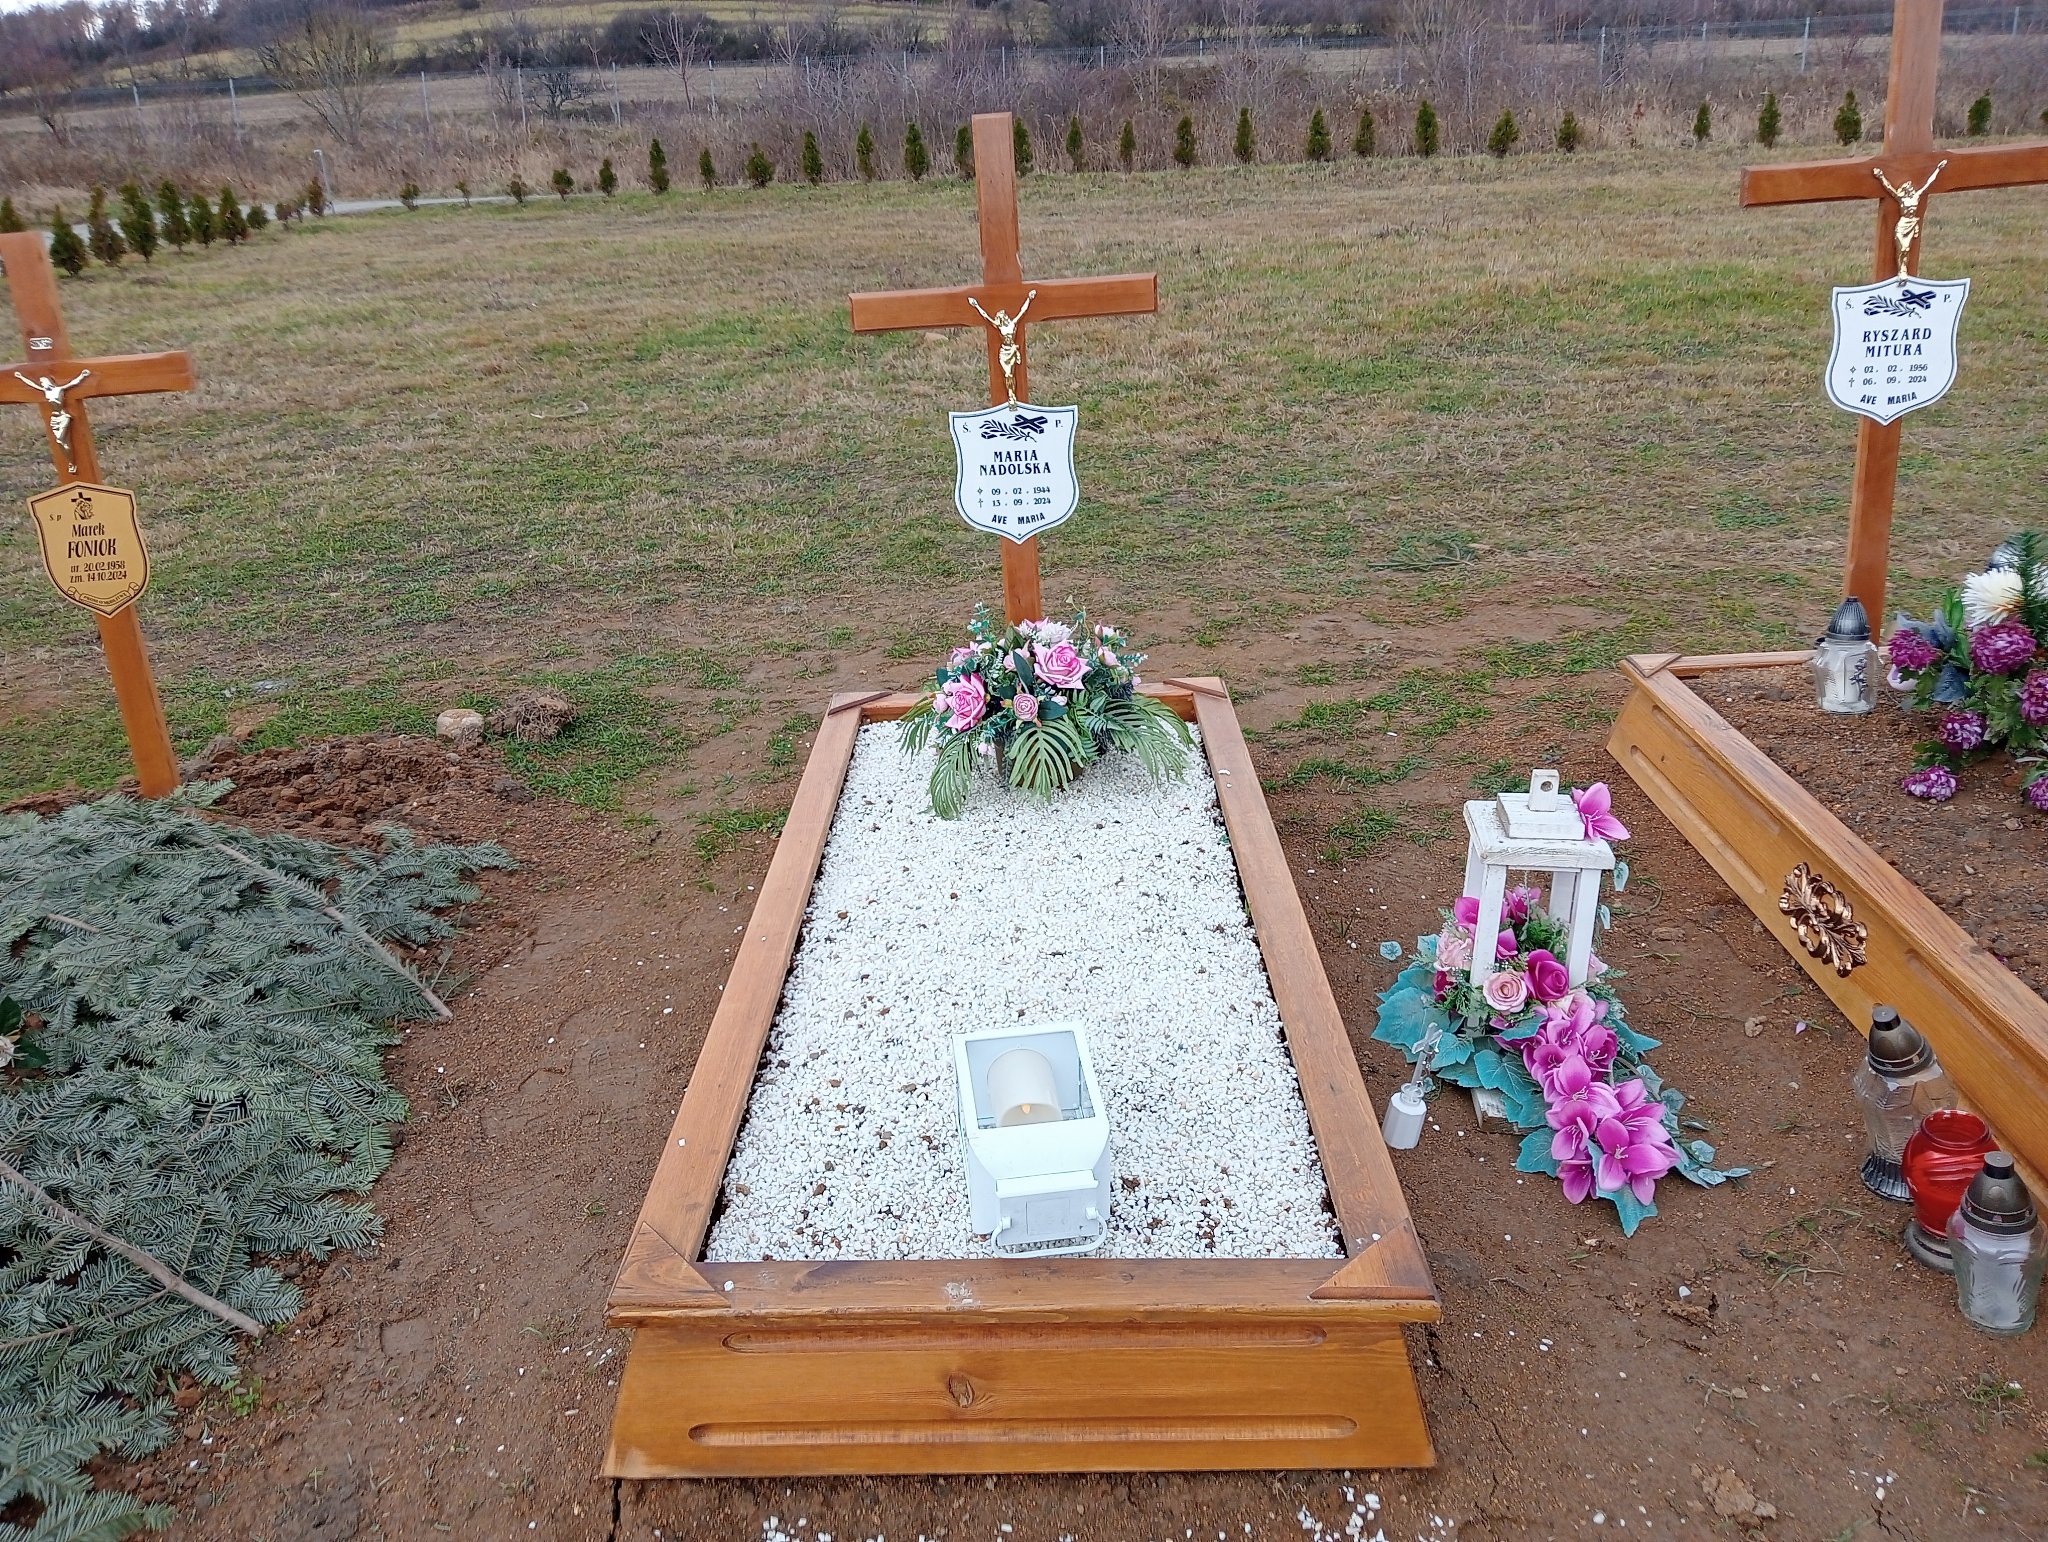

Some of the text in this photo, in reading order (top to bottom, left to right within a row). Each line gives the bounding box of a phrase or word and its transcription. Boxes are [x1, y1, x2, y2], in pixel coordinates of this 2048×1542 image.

[1862, 328, 1932, 343] RYSZARD
[1865, 343, 1922, 358] MITURA
[1860, 392, 1917, 405] AVE MARIA
[994, 449, 1038, 462] MARIA
[980, 462, 1051, 476] NADOLSKA
[991, 512, 1046, 525] AVE MARIA
[71, 522, 105, 538] Marek
[67, 538, 117, 559] FONIOK
